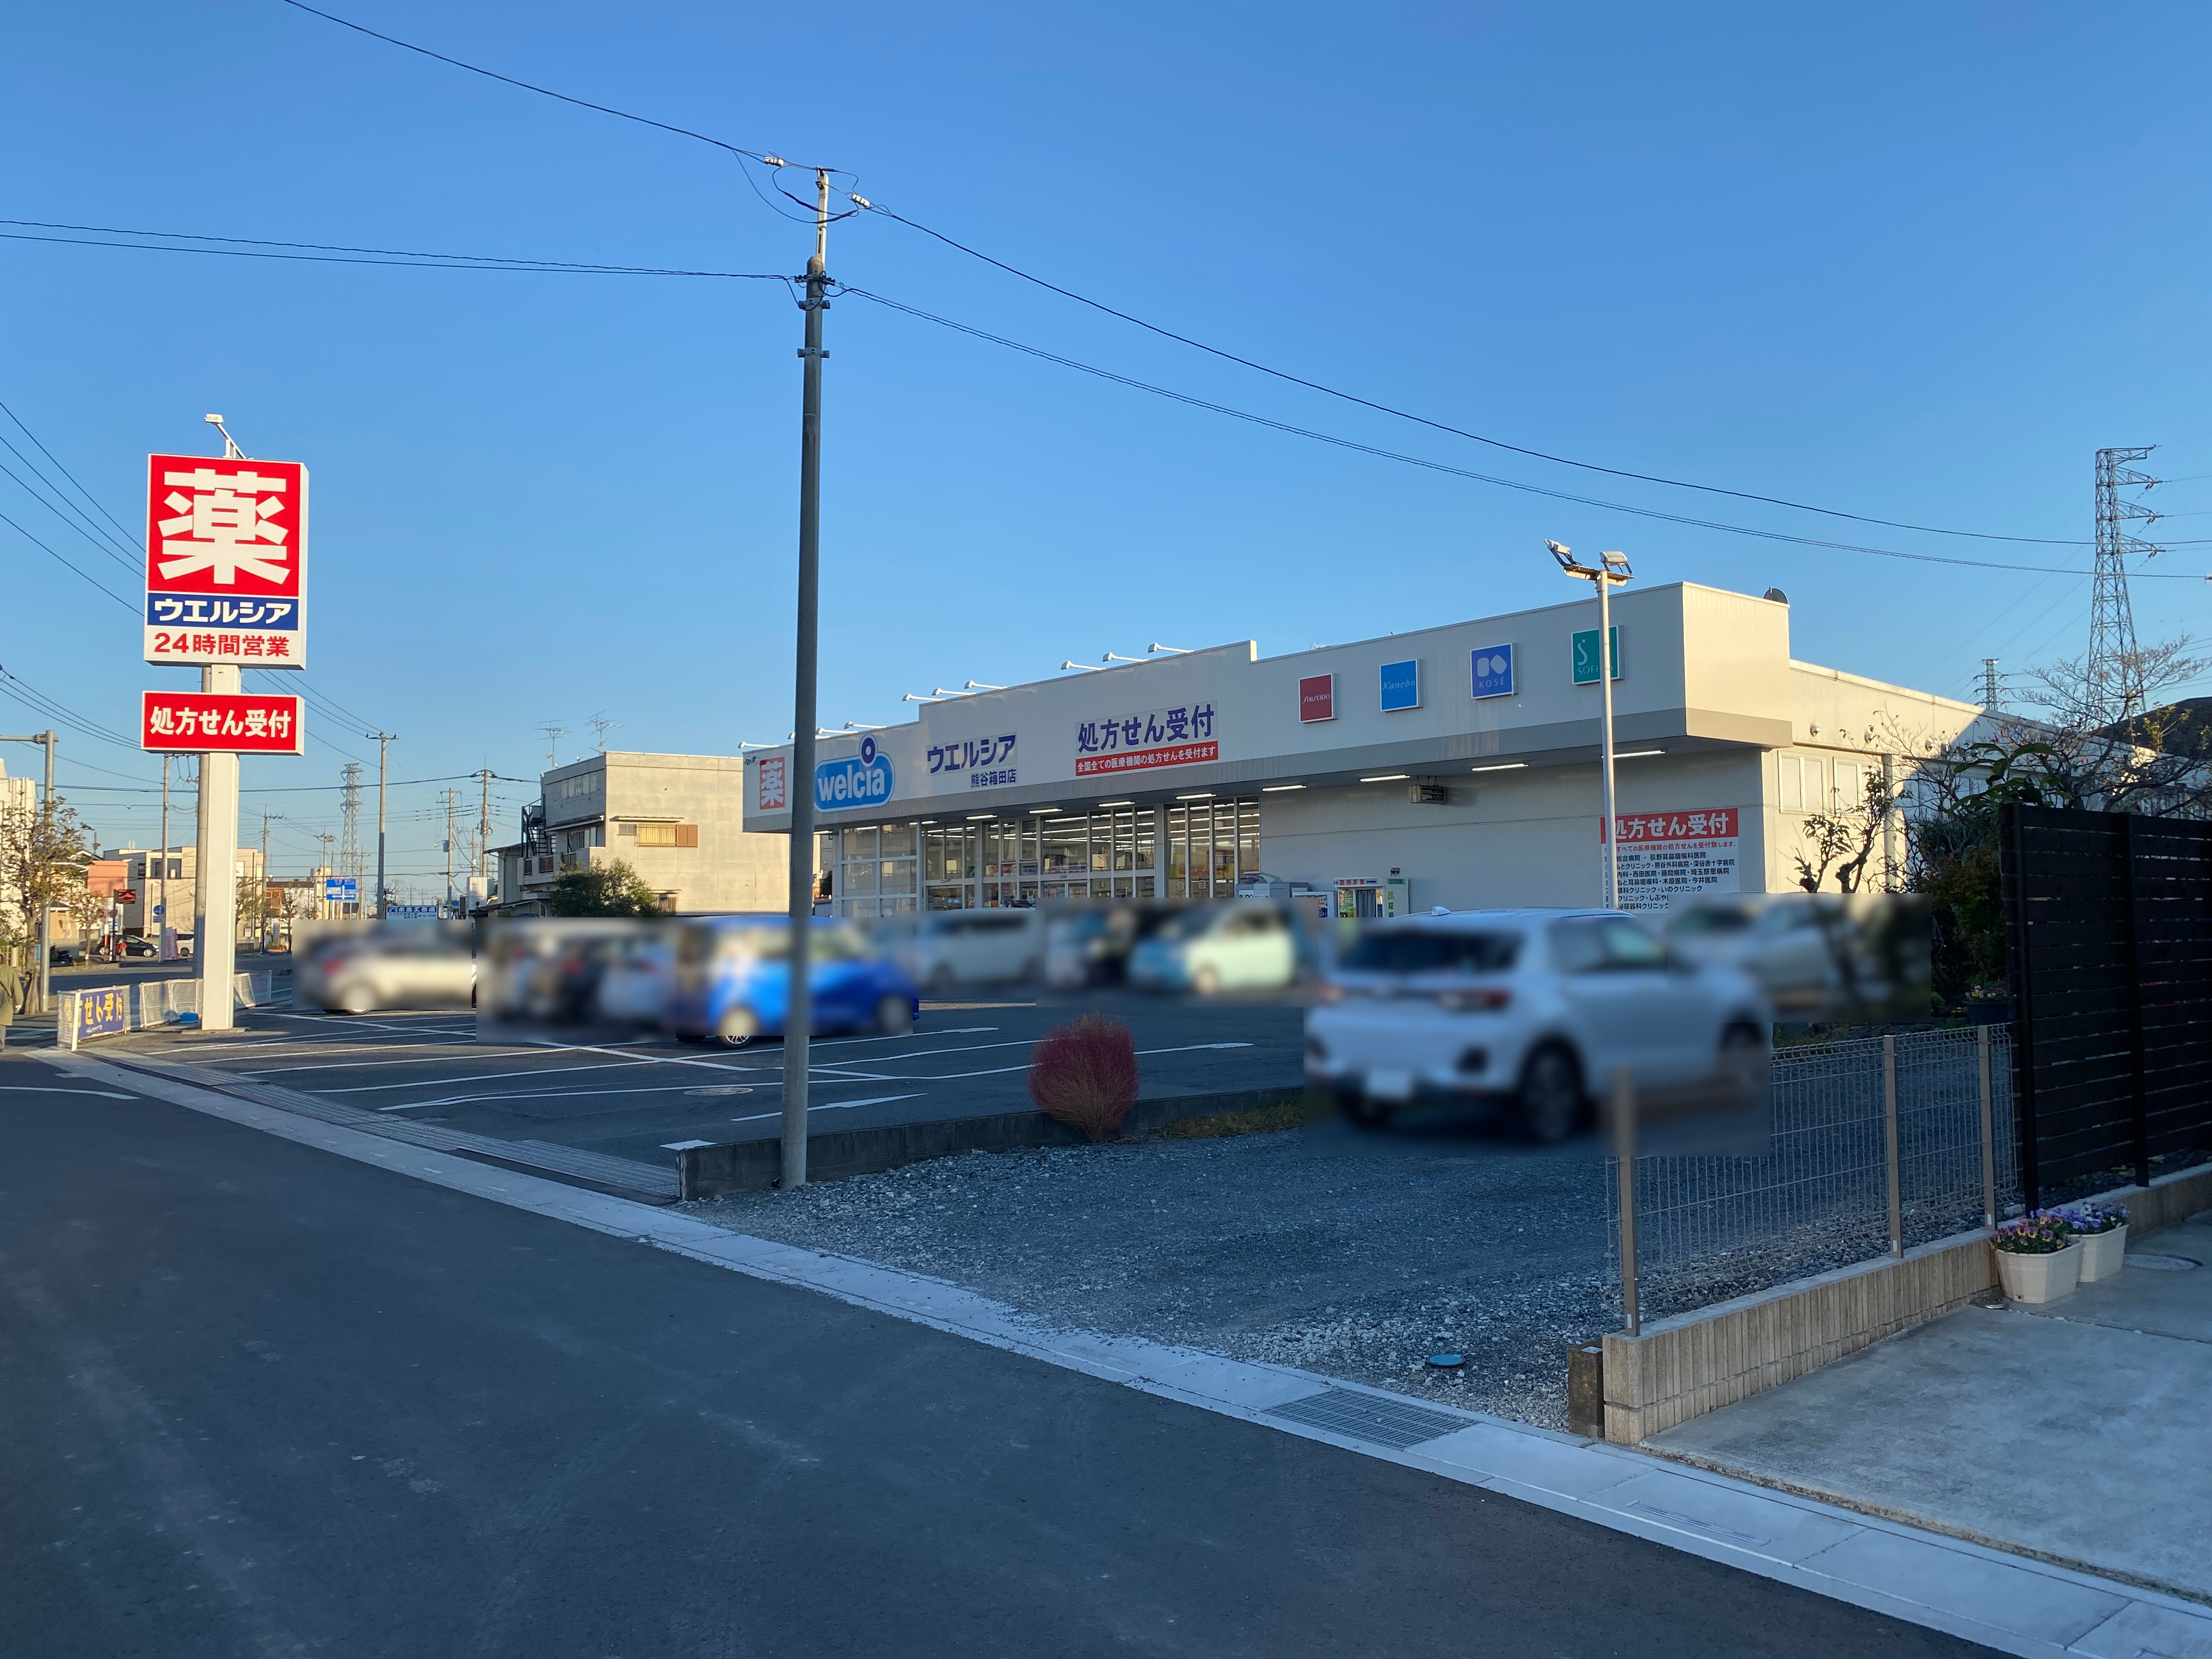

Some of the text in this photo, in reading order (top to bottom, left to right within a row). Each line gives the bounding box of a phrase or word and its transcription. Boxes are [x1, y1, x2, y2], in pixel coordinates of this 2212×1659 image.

[157, 469, 290, 585] 薬
[155, 599, 291, 624] ウエルシア
[154, 634, 290, 657] 24時間営業
[1577, 664, 1614, 675] SOFI
[1383, 679, 1415, 691] Kanebo
[1479, 675, 1505, 689] KOSÉ
[1302, 693, 1331, 704] SHISEIDO
[150, 706, 291, 738] 処方せん受付
[1078, 704, 1214, 753] 処方せん受付
[927, 735, 1016, 774] ウエルシア
[817, 737, 885, 802] welcia
[971, 769, 1016, 788] 熊谷箱田店
[761, 761, 783, 806] 薬
[1604, 841, 1736, 853] すべての医療機関の処方せんを受付致します。
